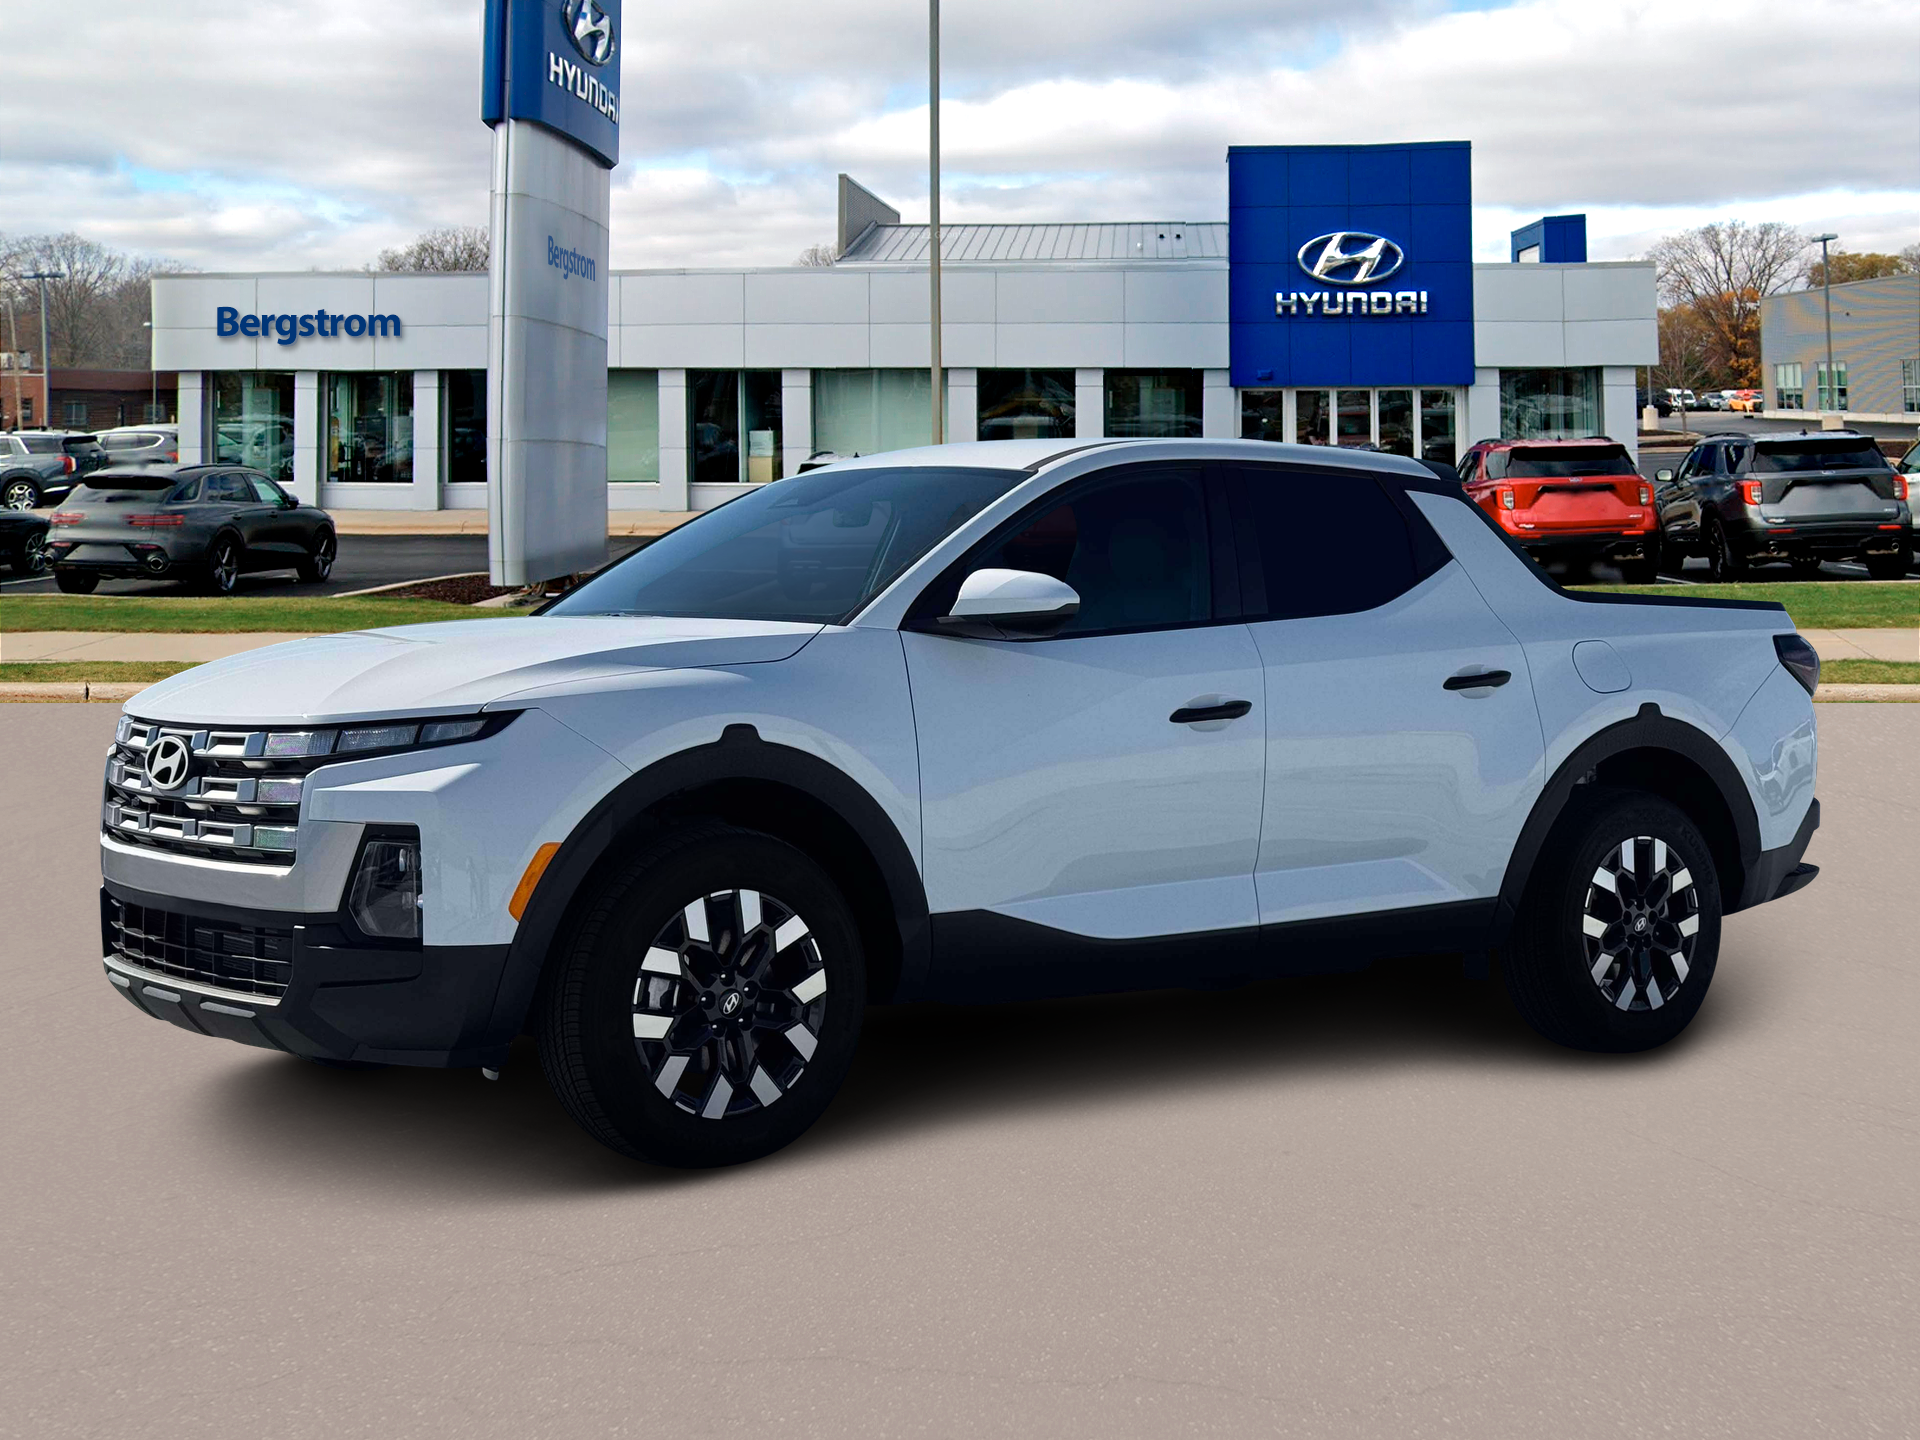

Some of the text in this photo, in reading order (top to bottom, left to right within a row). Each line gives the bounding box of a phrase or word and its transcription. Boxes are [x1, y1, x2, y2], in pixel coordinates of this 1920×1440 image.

[549, 52, 619, 124] HYUNDAI
[548, 235, 595, 281] Bergstrom
[1275, 291, 1428, 315] HYUNDAI
[217, 306, 401, 345] Bergstrom
